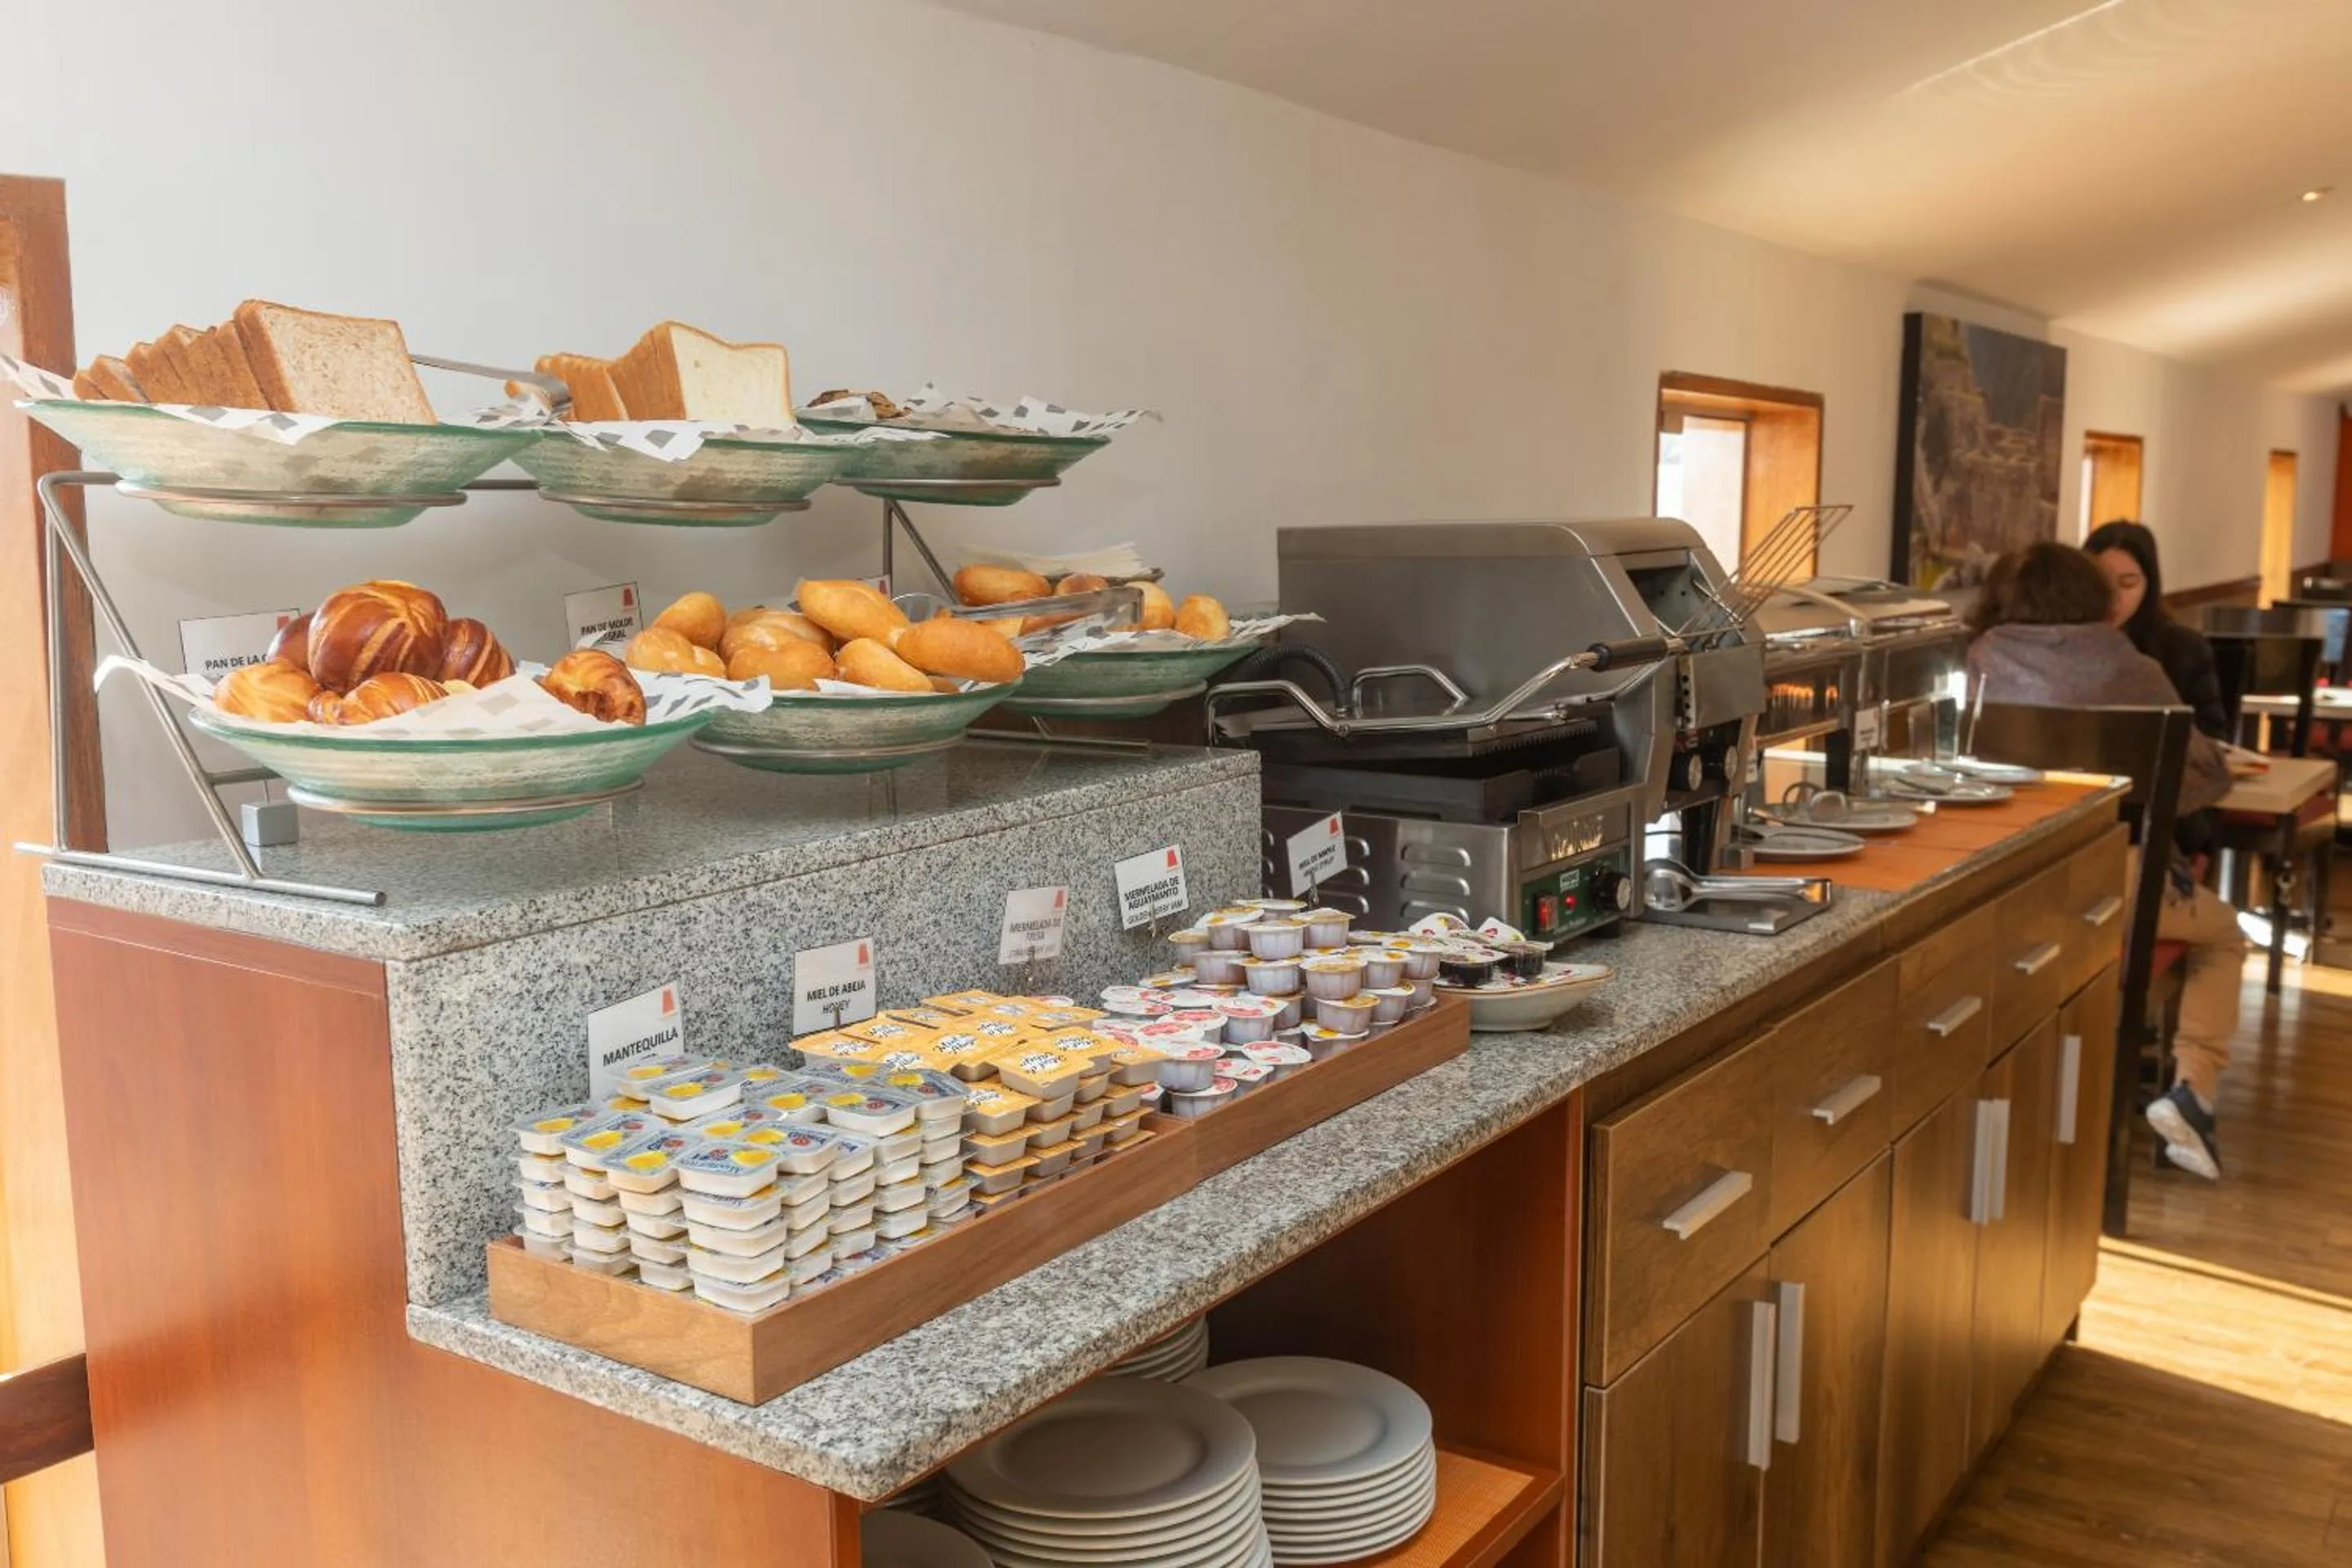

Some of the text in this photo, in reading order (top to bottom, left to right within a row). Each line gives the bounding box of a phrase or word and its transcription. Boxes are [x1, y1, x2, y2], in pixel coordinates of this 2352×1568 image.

[205, 659, 228, 670] PAN
[229, 656, 245, 666] DE
[247, 654, 260, 664] LA
[1169, 875, 1180, 887] DE
[807, 979, 866, 1002] MIEL DE ABEJA
[603, 1027, 679, 1067] MANTEQUILLA
